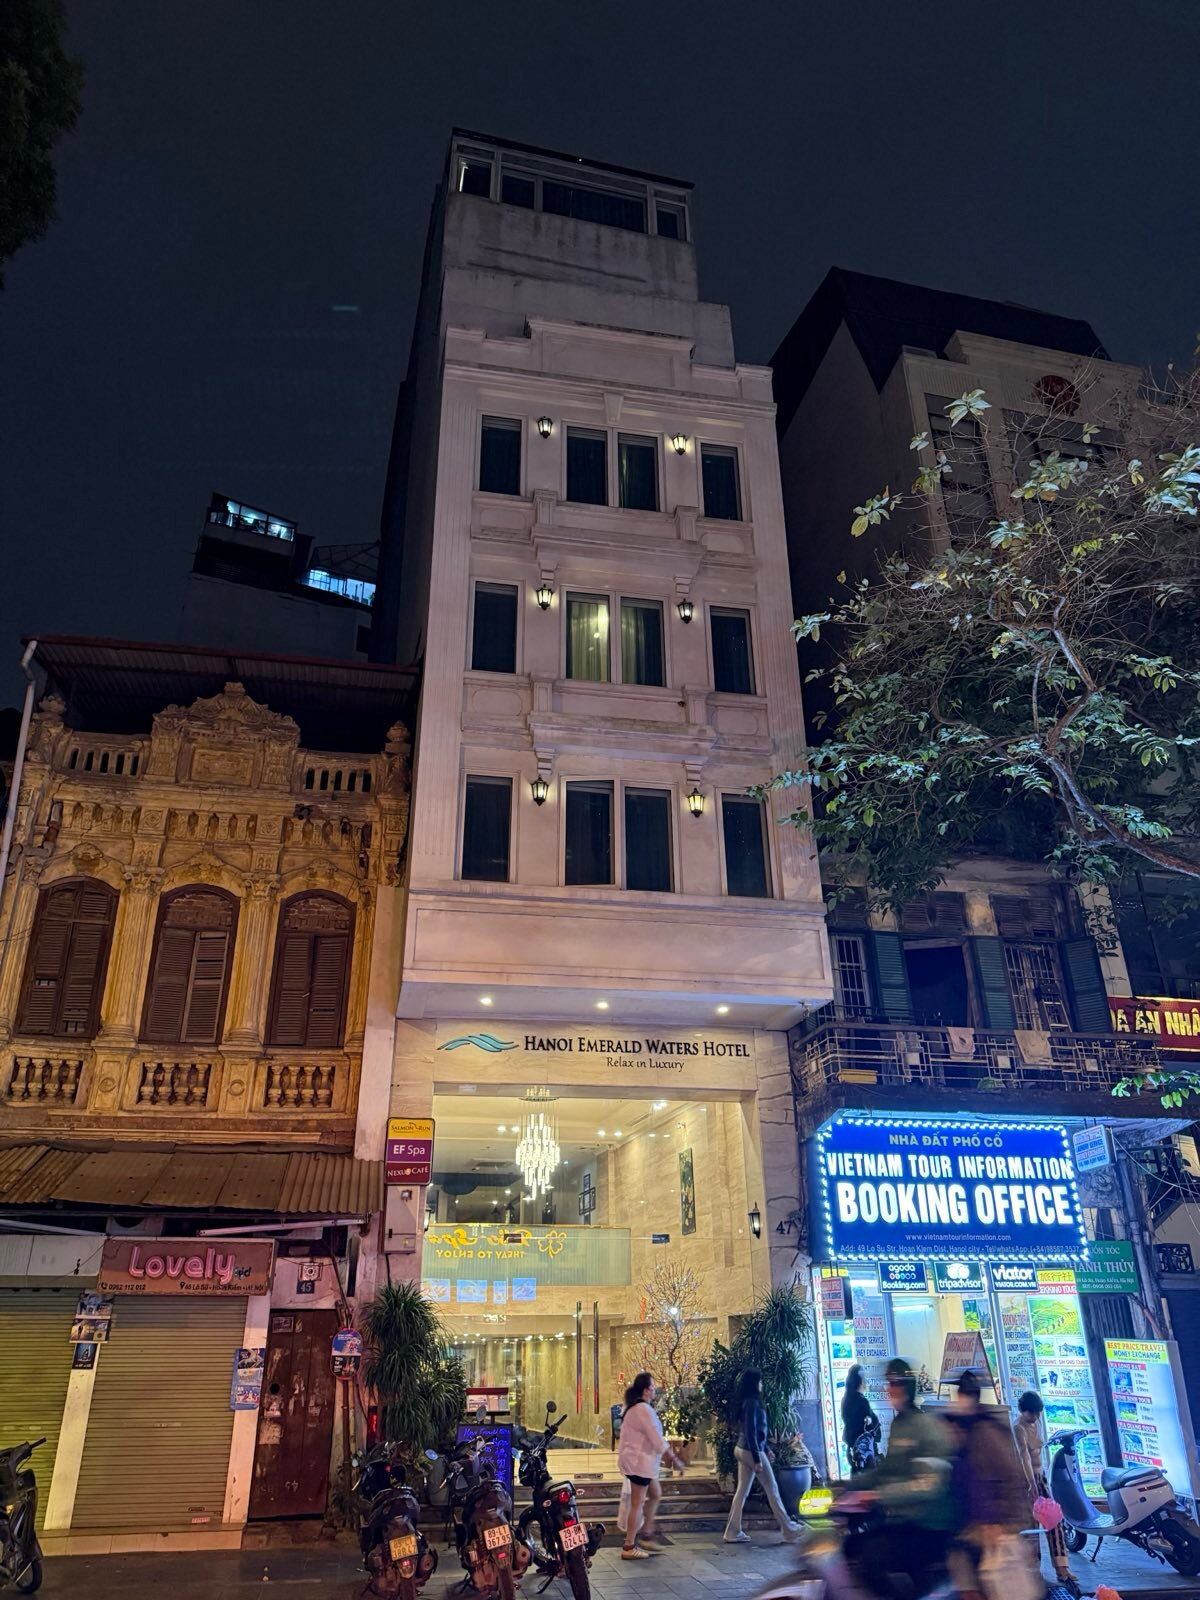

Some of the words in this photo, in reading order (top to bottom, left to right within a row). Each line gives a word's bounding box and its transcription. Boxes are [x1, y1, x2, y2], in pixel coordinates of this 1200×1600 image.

[524, 1036, 572, 1051] HANOI
[578, 1038, 642, 1054] EMERALD
[646, 1038, 699, 1056] WATERS
[704, 1042, 750, 1058] HOTEL
[606, 1056, 634, 1068] Relax
[649, 1058, 685, 1072] Luxury
[888, 1132, 919, 1146] NHÀ
[922, 1130, 949, 1146] ĐẤT
[952, 1130, 981, 1148] PHỐ
[984, 1130, 1004, 1148] CỔ
[393, 1144, 406, 1154] EF
[407, 1144, 426, 1157] Spa
[826, 1152, 904, 1177] VIETNAM
[908, 1154, 953, 1178] TOUR
[958, 1156, 1074, 1180] INFORMATION
[836, 1182, 970, 1224] BOOKING
[974, 1184, 1074, 1224] OFFICE
[776, 1220, 792, 1235] 47
[905, 1233, 1012, 1241] www.vietnamtourinformation.com
[840, 1244, 856, 1252] Add:
[866, 1244, 876, 1252] Lo
[876, 1244, 886, 1252] Su
[898, 1244, 916, 1252] Hoan
[128, 1246, 236, 1286] Lovely
[888, 1263, 916, 1274] agoda
[1104, 1258, 1135, 1273] THỦY
[993, 1266, 1034, 1280] viator
[300, 1282, 312, 1292] 45
[882, 1280, 926, 1290] Booking.com
[938, 1278, 982, 1290] tripadvisor
[1106, 1342, 1121, 1350] BEST
[1122, 1342, 1140, 1350] PRICE
[1140, 1343, 1165, 1352] TRAVEL
[1113, 1350, 1131, 1358] MONEY
[1131, 1351, 1161, 1360] EXCHANGE
[487, 1526, 508, 1539] 89-L1
